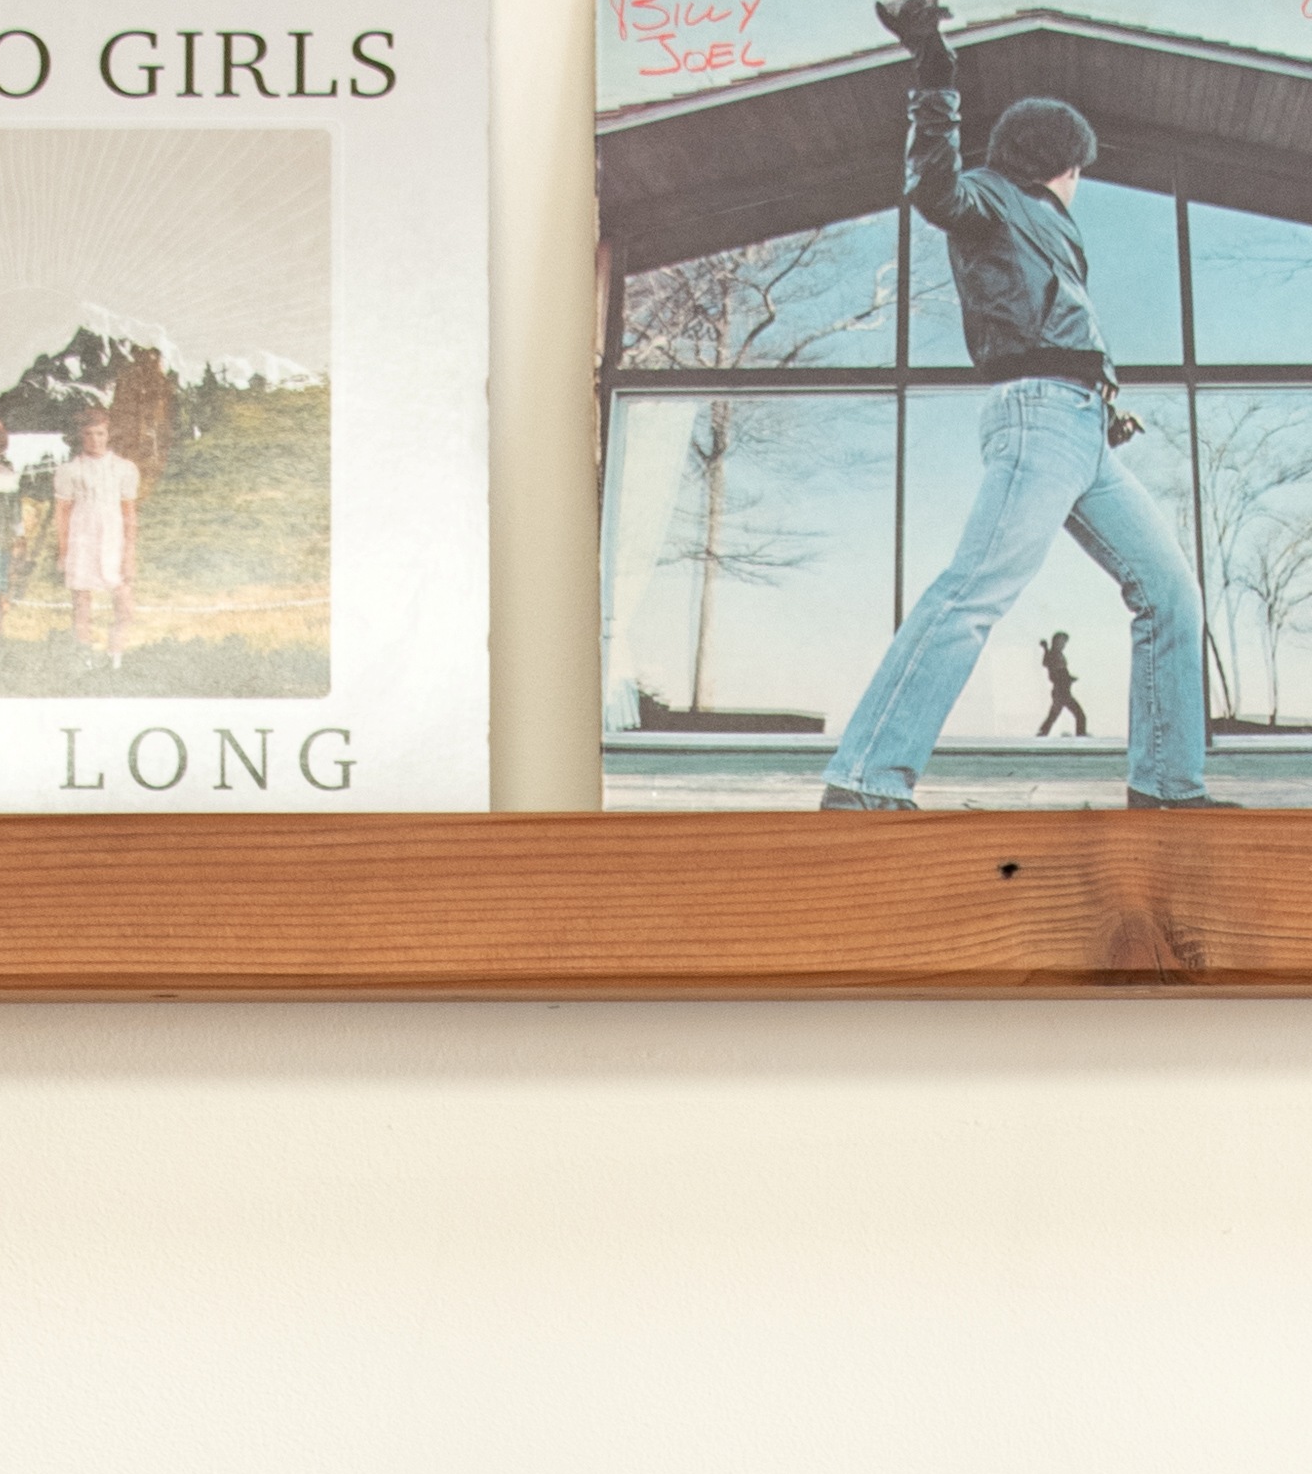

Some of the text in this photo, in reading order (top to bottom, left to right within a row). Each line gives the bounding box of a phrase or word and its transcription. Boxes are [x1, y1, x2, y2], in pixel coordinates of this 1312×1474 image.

[99, 29, 399, 99] GIRLS
[636, 33, 766, 76] JOEL
[59, 727, 358, 792] LONG
